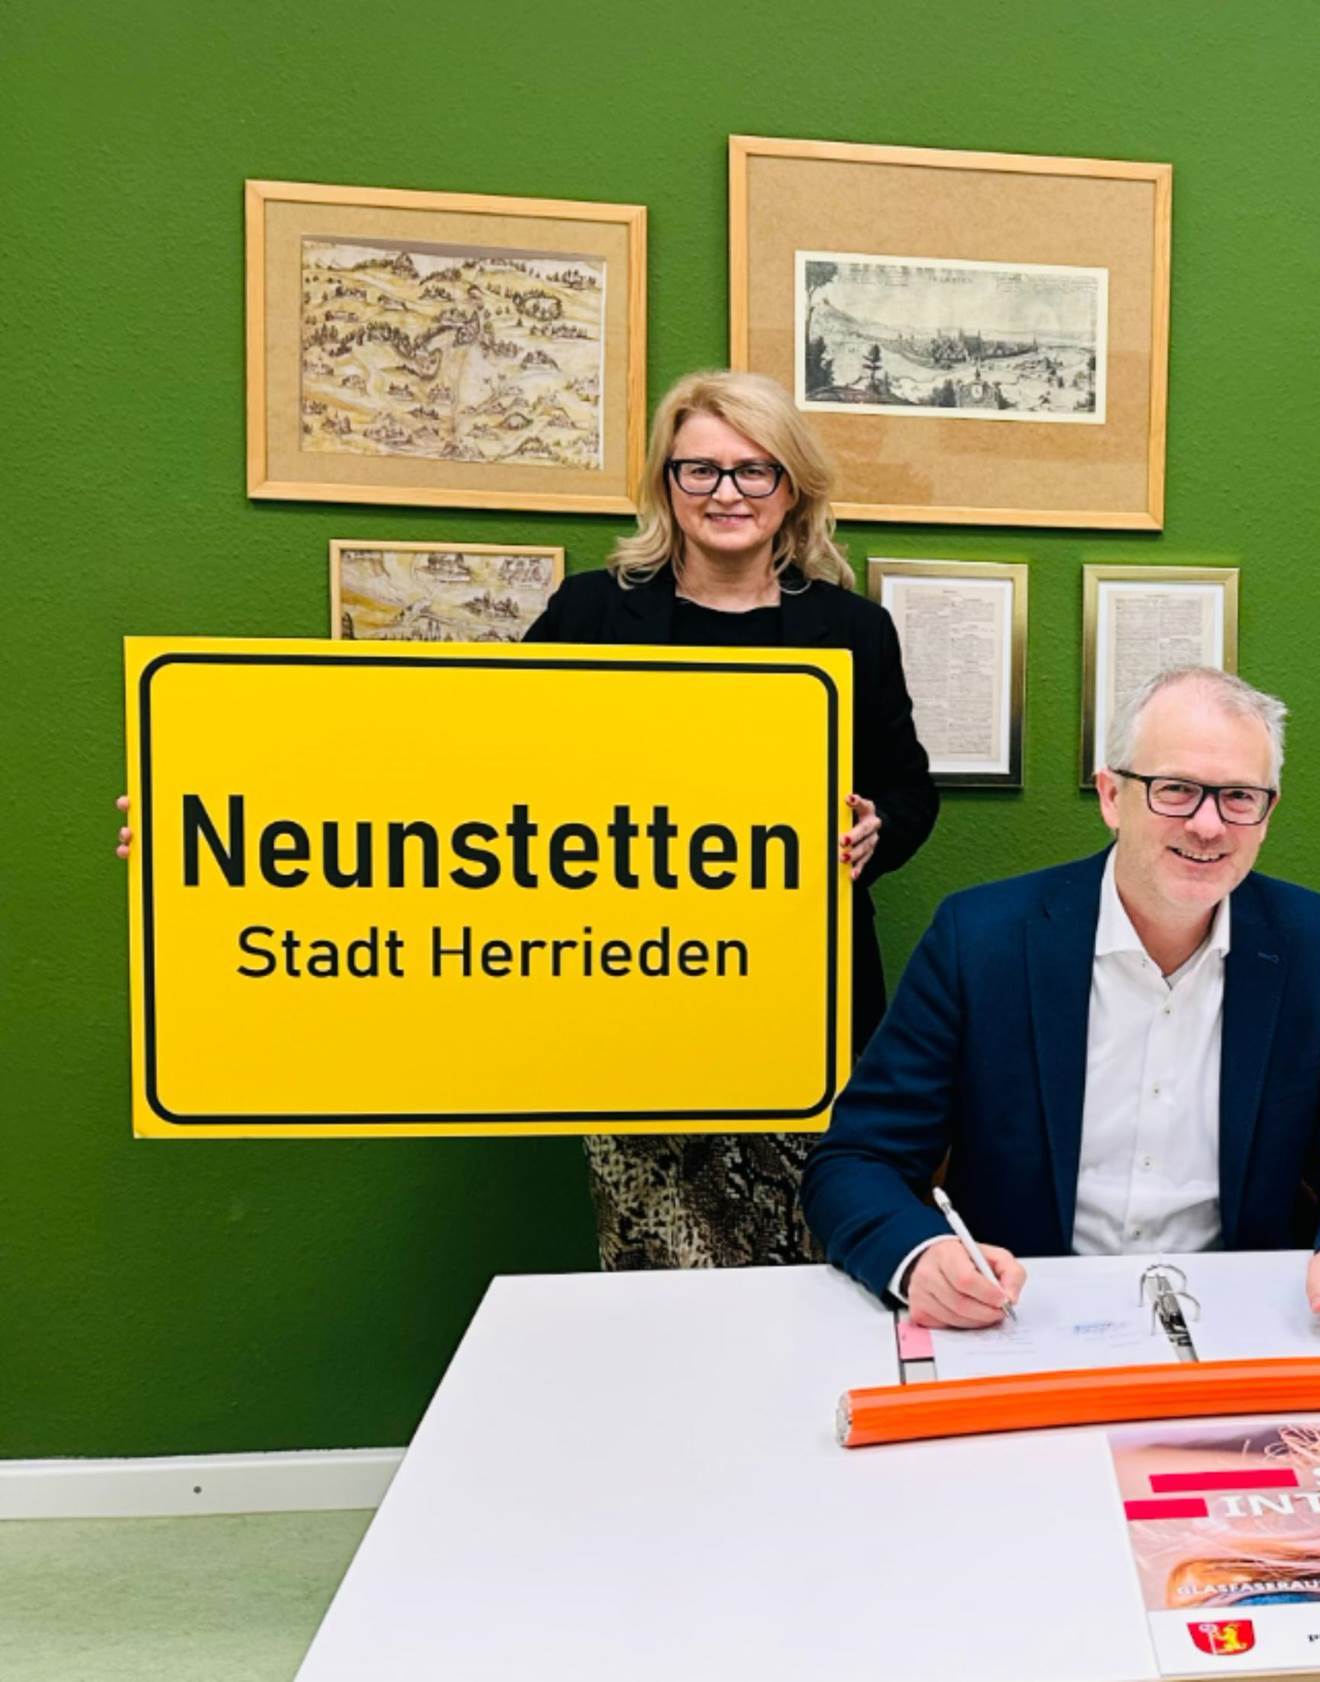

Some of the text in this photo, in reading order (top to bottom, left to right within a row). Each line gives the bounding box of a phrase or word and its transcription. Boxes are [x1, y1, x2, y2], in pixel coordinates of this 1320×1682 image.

[181, 793, 801, 890] Neunstetten
[235, 925, 749, 979] Stadt Herrieden
